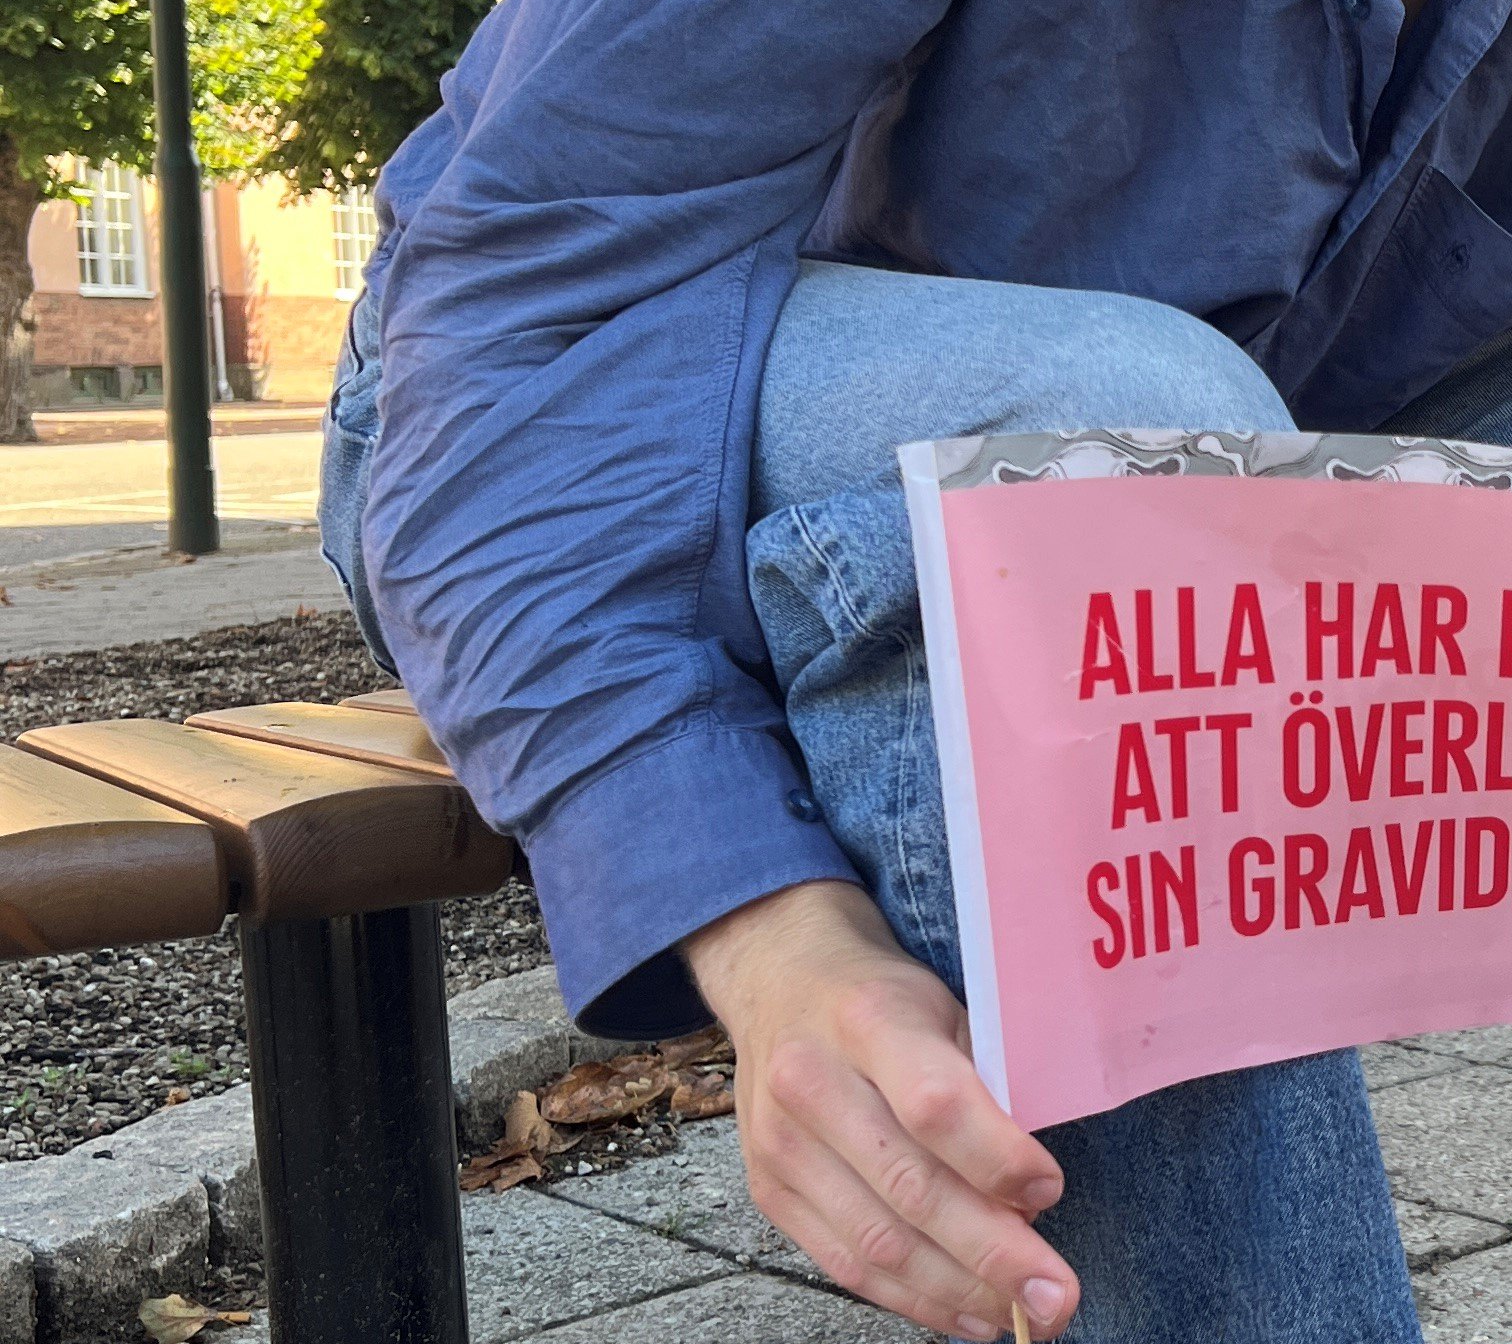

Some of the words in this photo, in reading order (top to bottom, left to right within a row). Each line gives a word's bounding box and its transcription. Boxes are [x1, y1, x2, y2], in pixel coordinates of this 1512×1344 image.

[1079, 583, 1275, 701] ALLA
[1305, 581, 1468, 682] HAR
[1111, 713, 1253, 830] ATT
[1086, 845, 1199, 970] SIN
